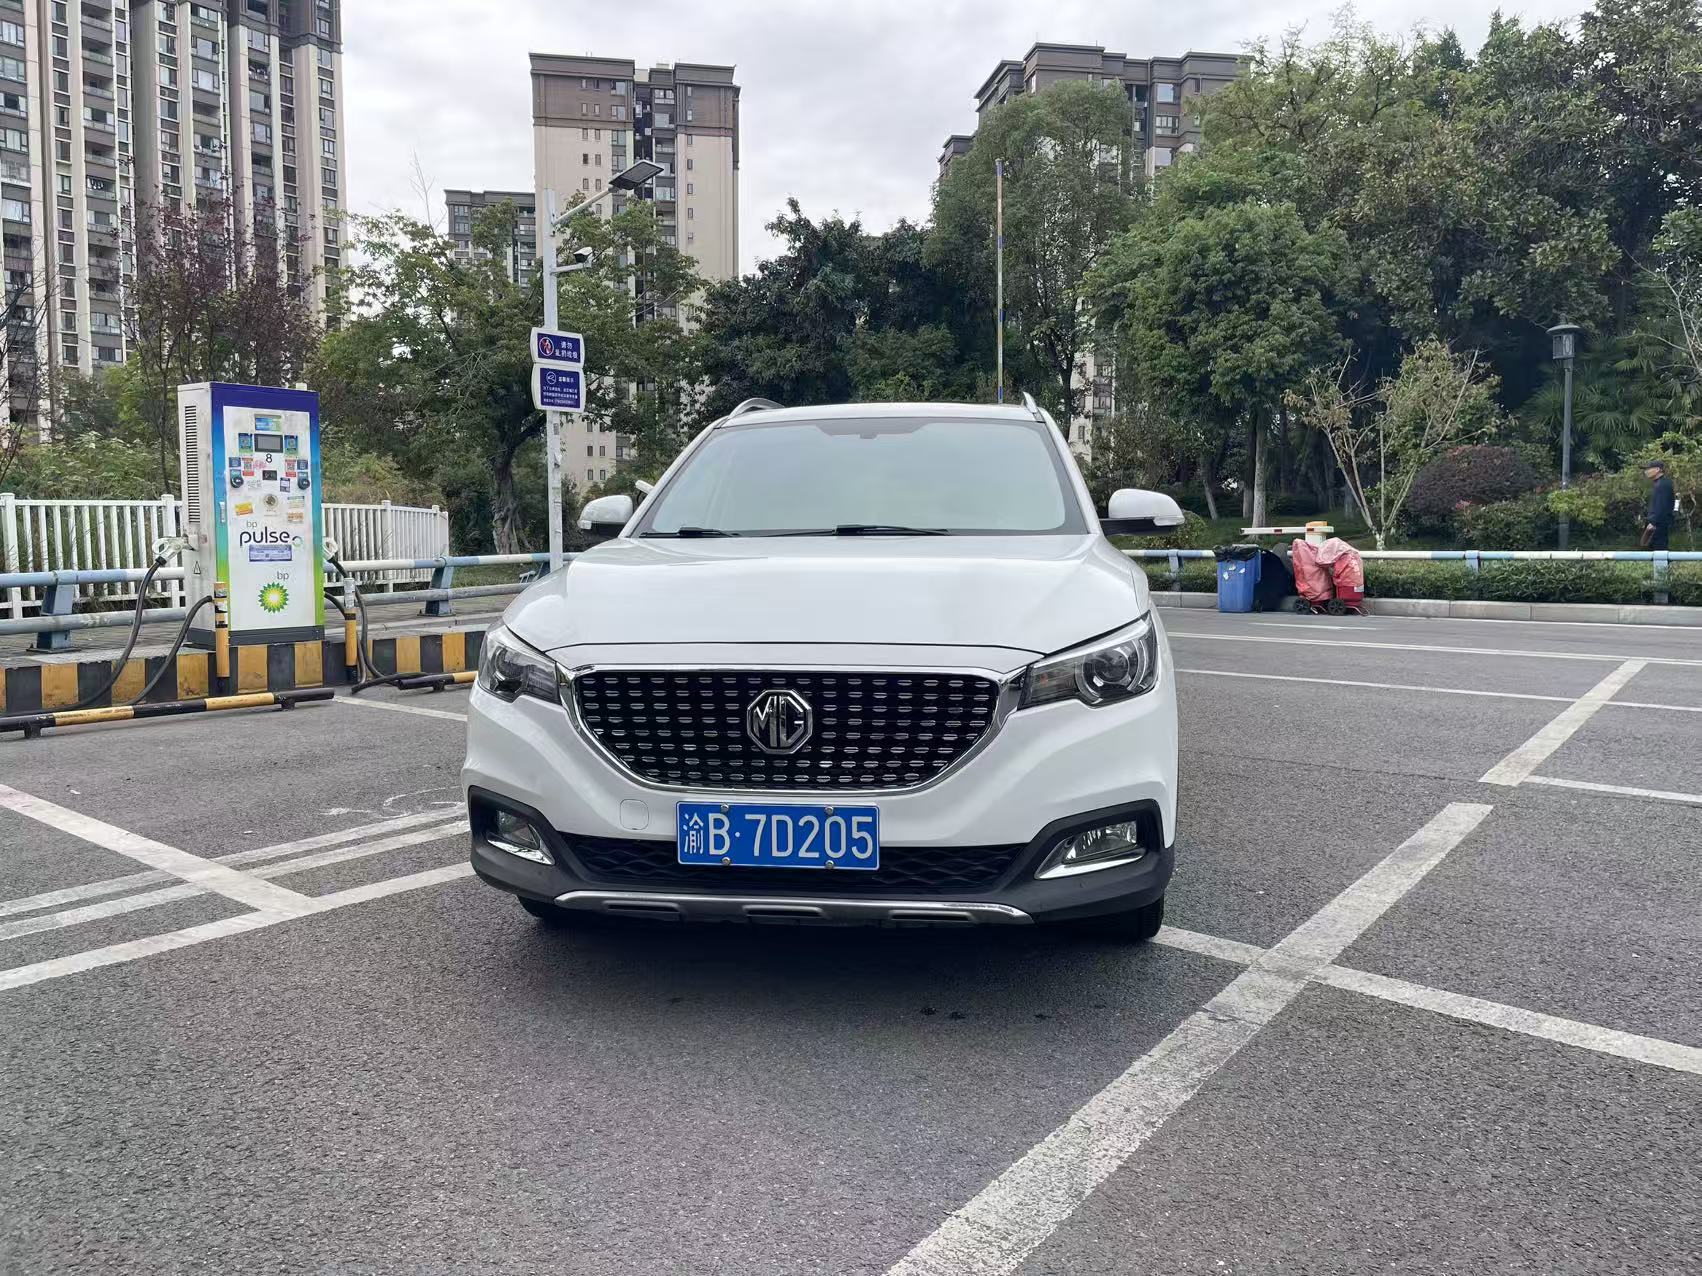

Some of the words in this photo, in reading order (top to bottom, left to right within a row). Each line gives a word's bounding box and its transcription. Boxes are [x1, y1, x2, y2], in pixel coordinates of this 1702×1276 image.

[265, 453, 273, 463] 8
[246, 520, 258, 528] bp
[240, 526, 290, 547] pulse
[276, 571, 290, 581] bp
[751, 693, 806, 750] MG
[684, 812, 874, 860] 渝B·7D205
